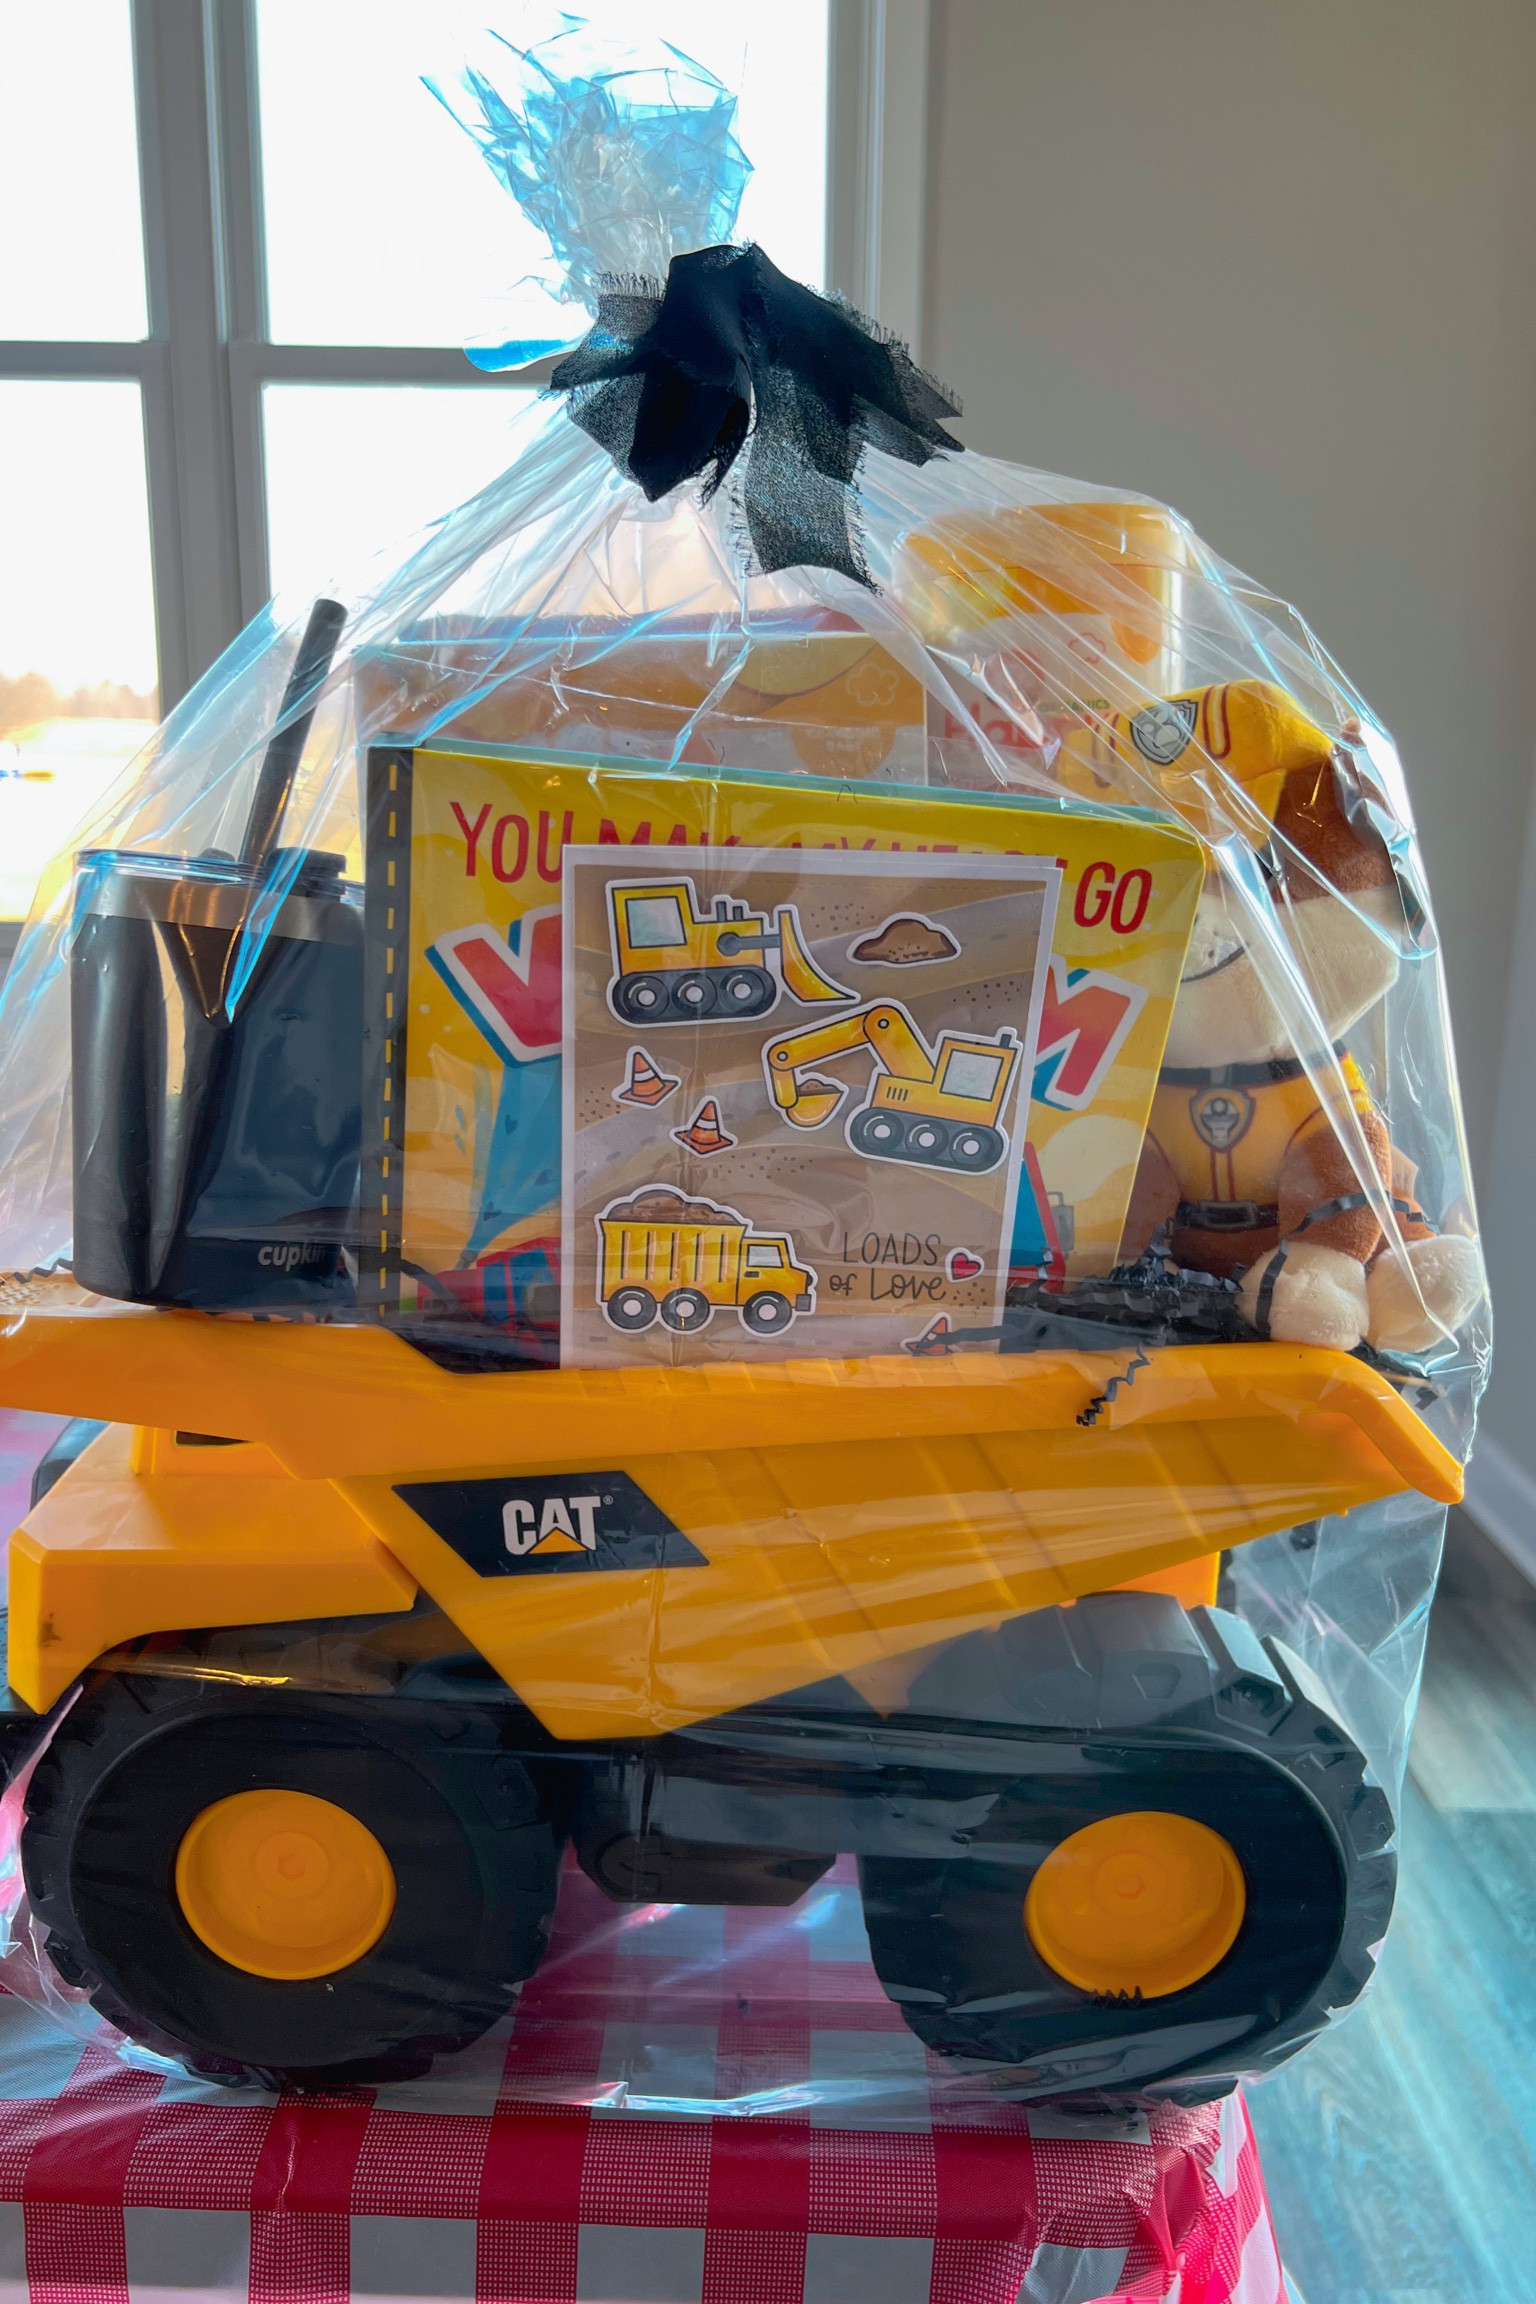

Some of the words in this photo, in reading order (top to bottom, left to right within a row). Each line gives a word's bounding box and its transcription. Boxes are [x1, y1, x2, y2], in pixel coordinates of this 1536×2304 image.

[449, 801, 574, 884] YOU
[1073, 860, 1153, 935] GO
[842, 1231, 942, 1267] LOADS
[828, 1272, 858, 1297] of
[870, 1267, 947, 1301] Love
